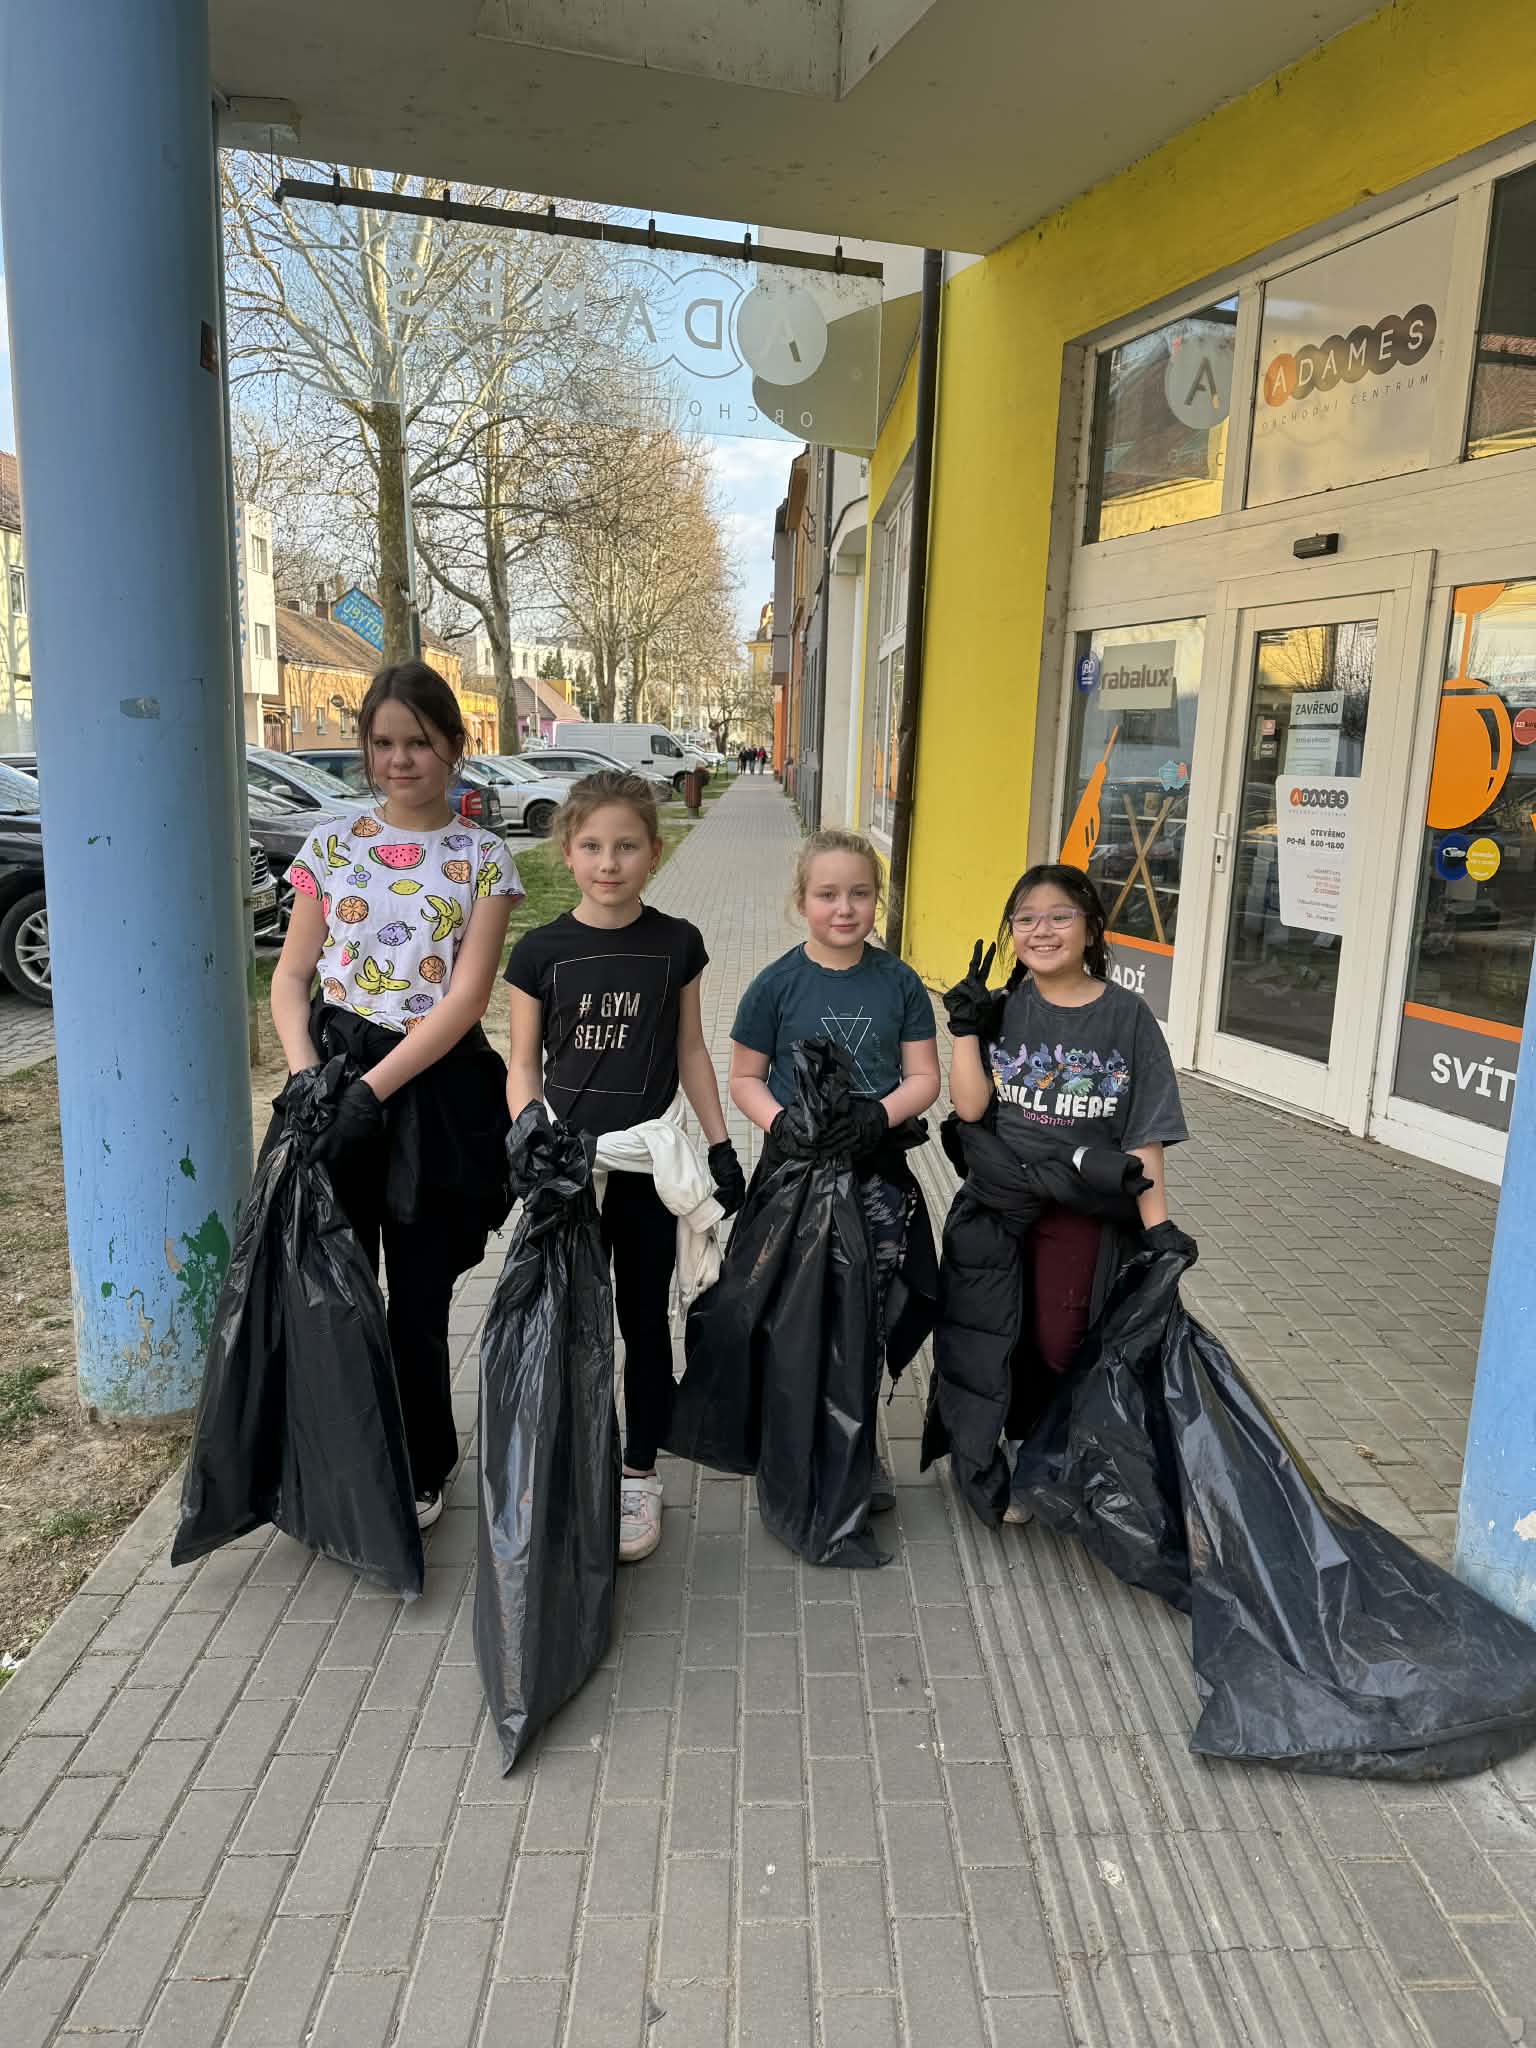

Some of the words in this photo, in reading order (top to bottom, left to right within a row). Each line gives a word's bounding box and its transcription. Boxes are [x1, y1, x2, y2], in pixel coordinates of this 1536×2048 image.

[1271, 319, 1424, 397] ADAMES
[1351, 373, 1429, 405] CENTRUM
[1101, 665, 1169, 690] rabalux
[1295, 700, 1339, 716] ZAVŘENO
[1291, 789, 1347, 807] ADAMES
[600, 991, 641, 1018] GYM
[574, 1023, 630, 1050] SELFIE
